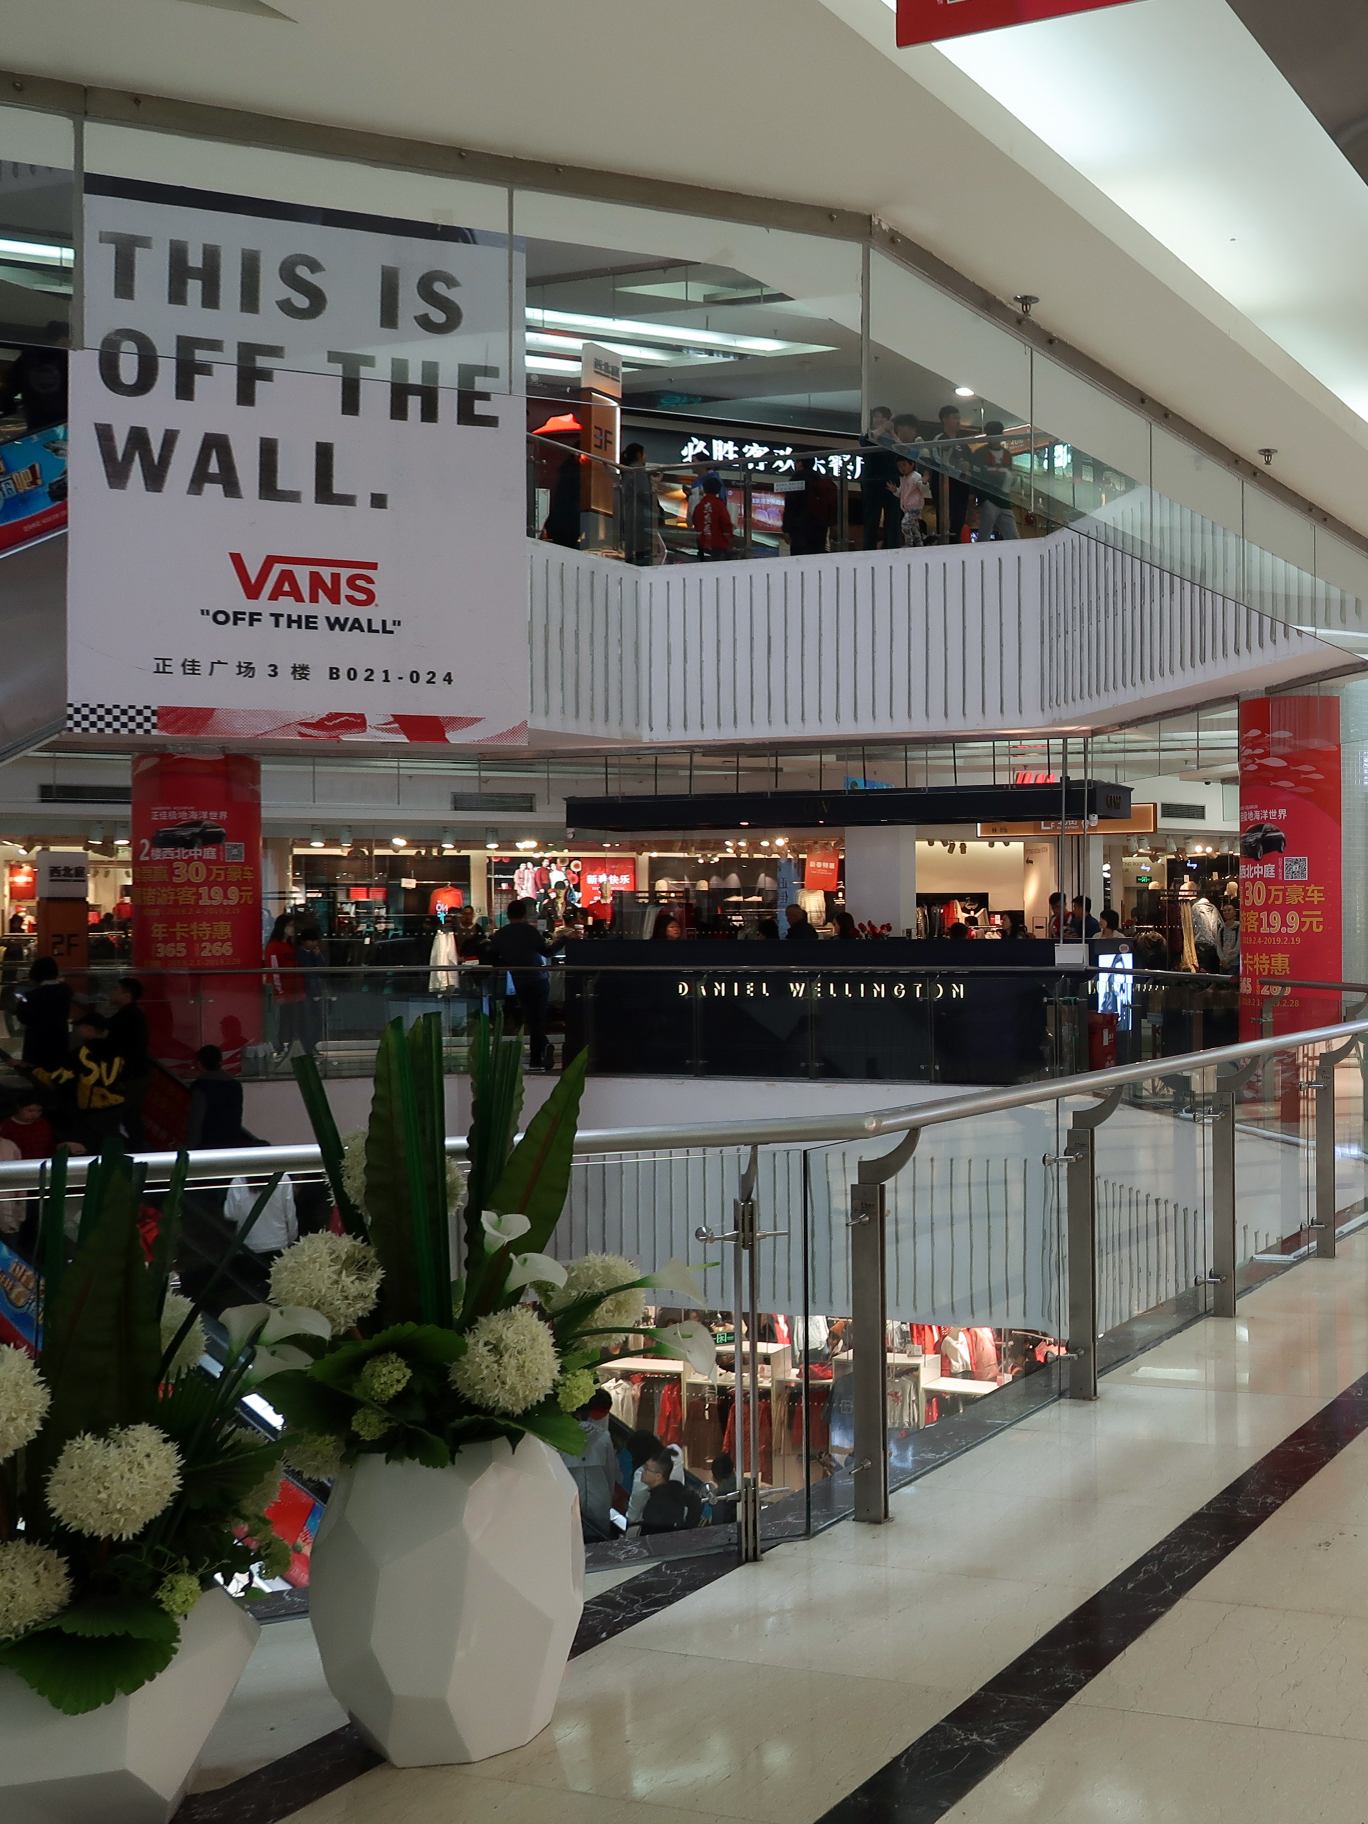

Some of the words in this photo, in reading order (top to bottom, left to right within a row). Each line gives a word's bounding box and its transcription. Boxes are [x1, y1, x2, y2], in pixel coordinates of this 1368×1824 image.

[98, 231, 328, 321] THIS
[379, 265, 463, 334] IS
[99, 328, 285, 406] OFF
[327, 350, 500, 428] THE
[94, 422, 389, 510] WALL.
[228, 552, 378, 607] VANS
[200, 609, 262, 627] "OFF
[270, 612, 319, 630] THE
[325, 615, 401, 635] WALL"
[328, 666, 454, 685] B021-024
[151, 811, 228, 821] 正佳极地海洋世界
[151, 922, 232, 940] 年卡特惠
[156, 943, 187, 957] 365
[201, 942, 234, 957] 266
[678, 981, 770, 998] DANIEL
[788, 981, 965, 999] WELLINGTON
